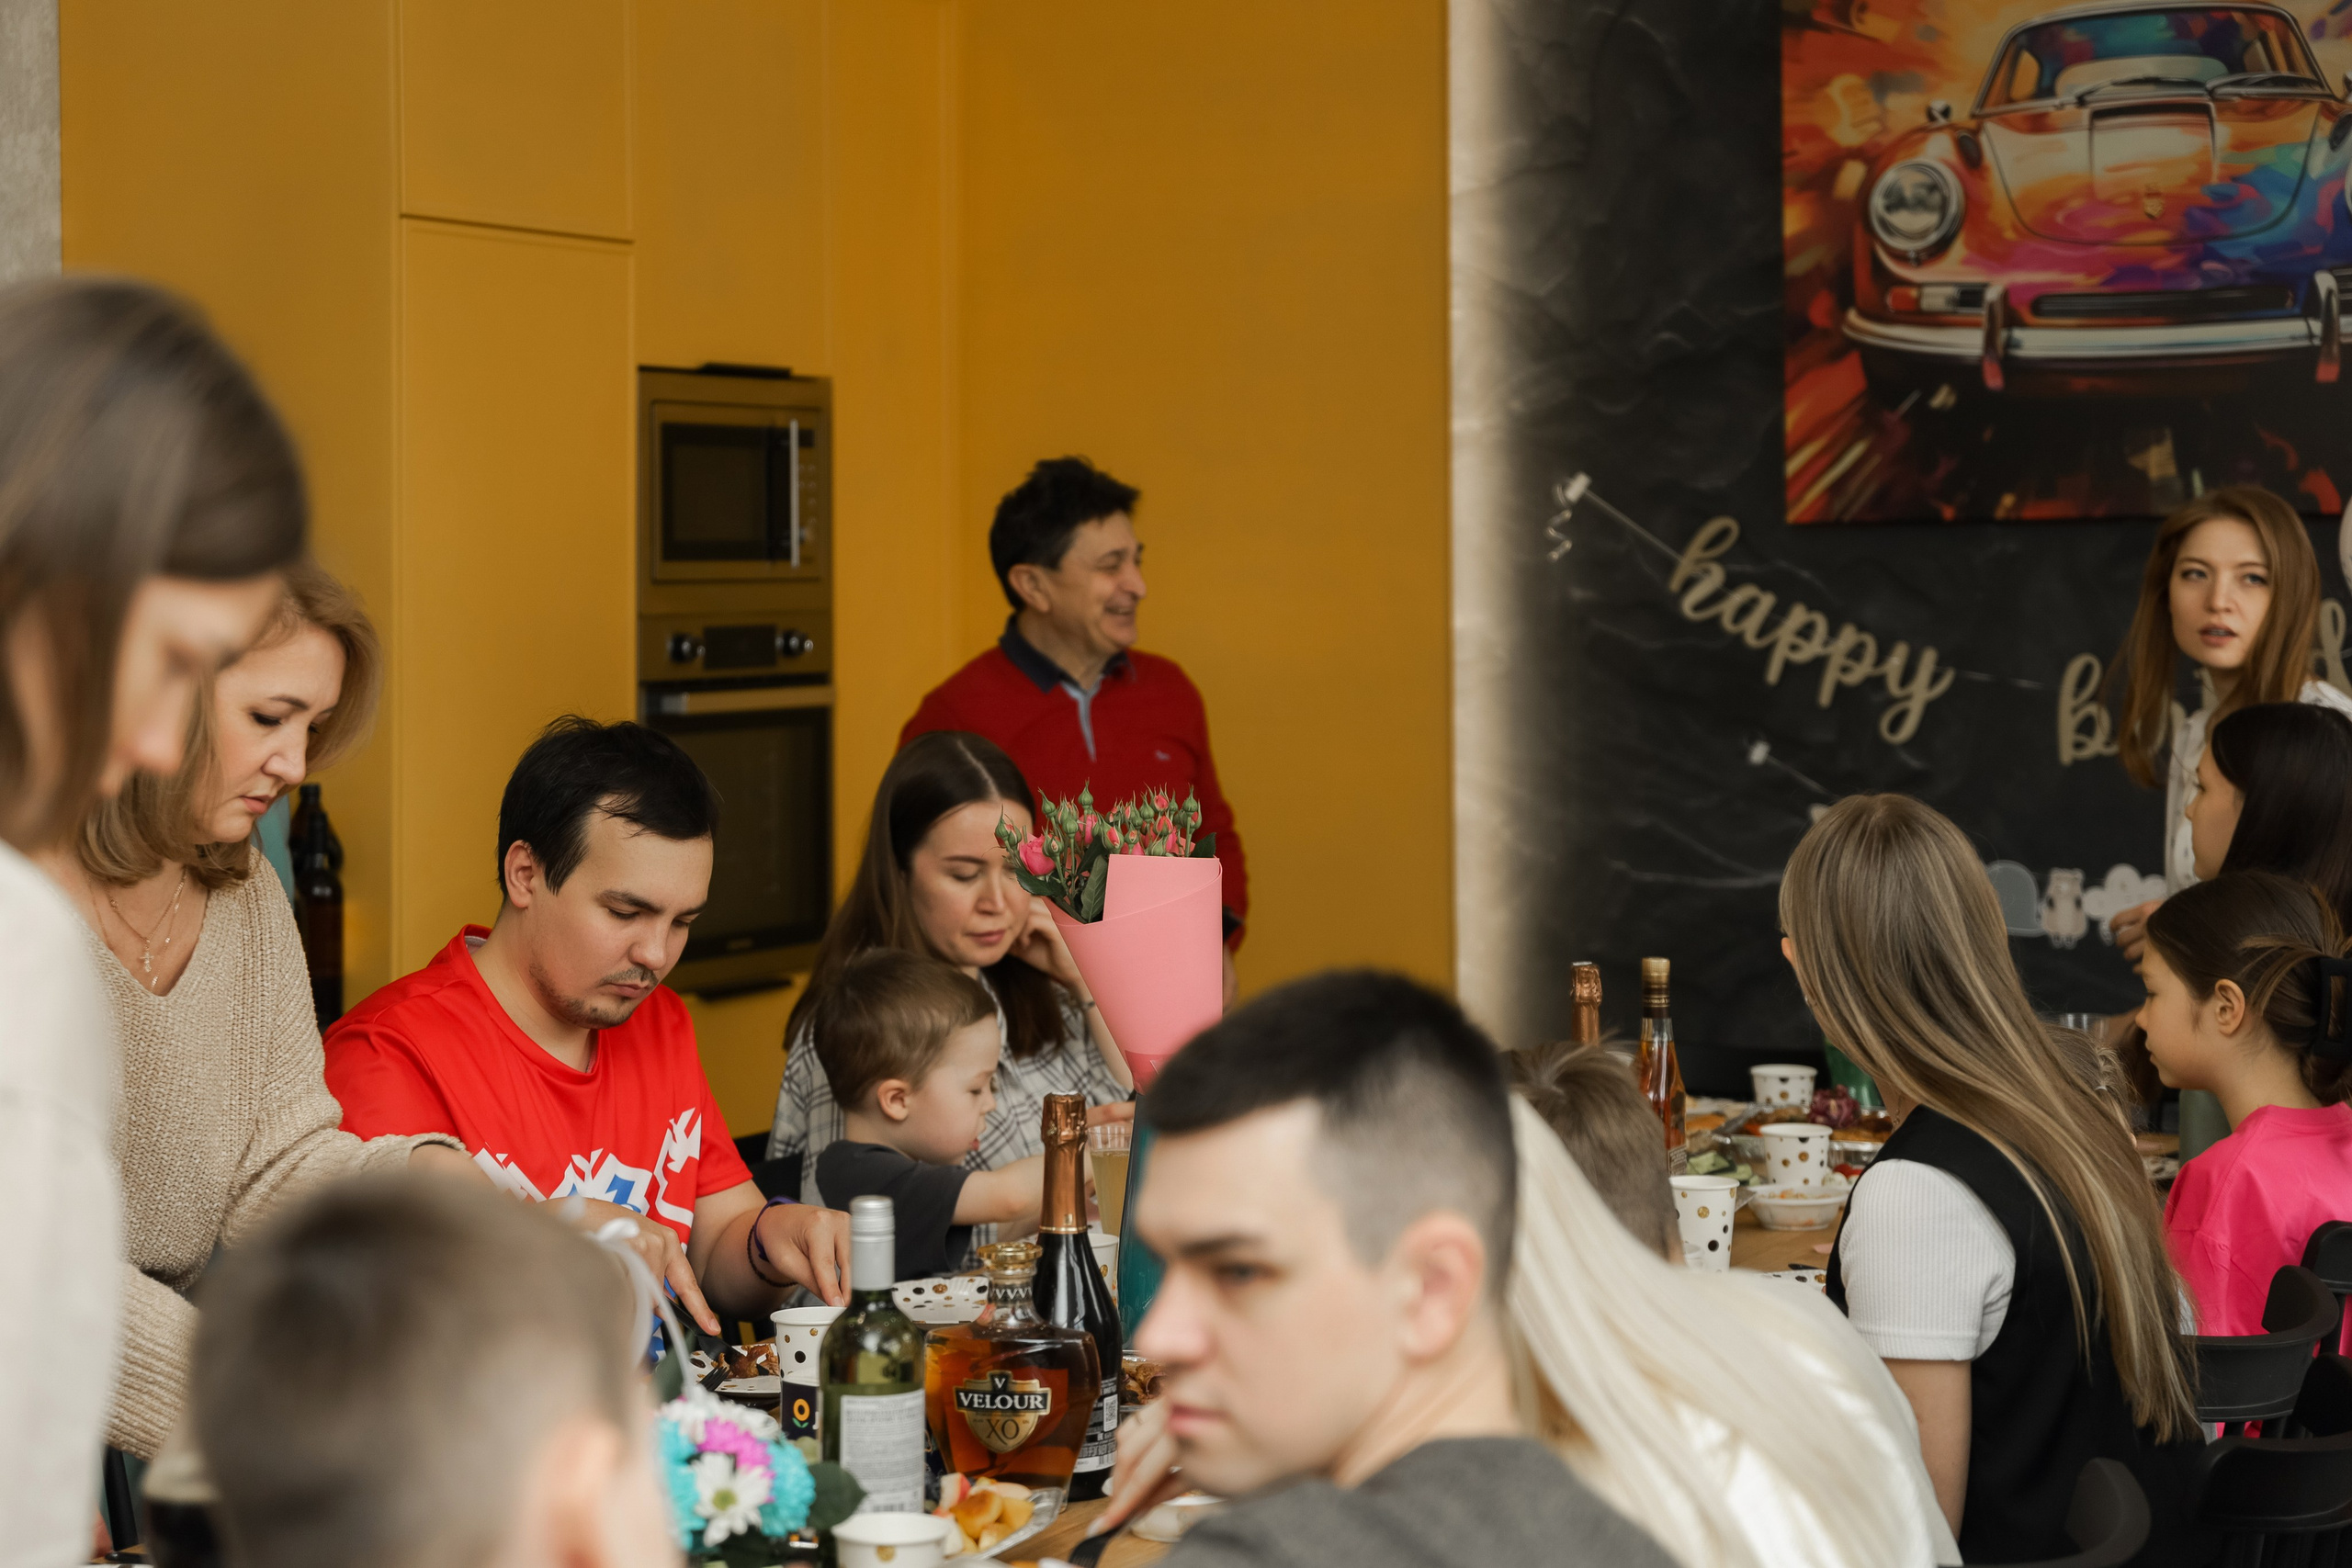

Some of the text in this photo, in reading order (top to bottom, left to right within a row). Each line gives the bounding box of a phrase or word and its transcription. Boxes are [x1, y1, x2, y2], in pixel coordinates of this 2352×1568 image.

[1668, 514, 1956, 745] happy
[994, 1377, 1006, 1389] V
[958, 1392, 1045, 1410] VELOUR
[986, 1418, 1020, 1446] XO
